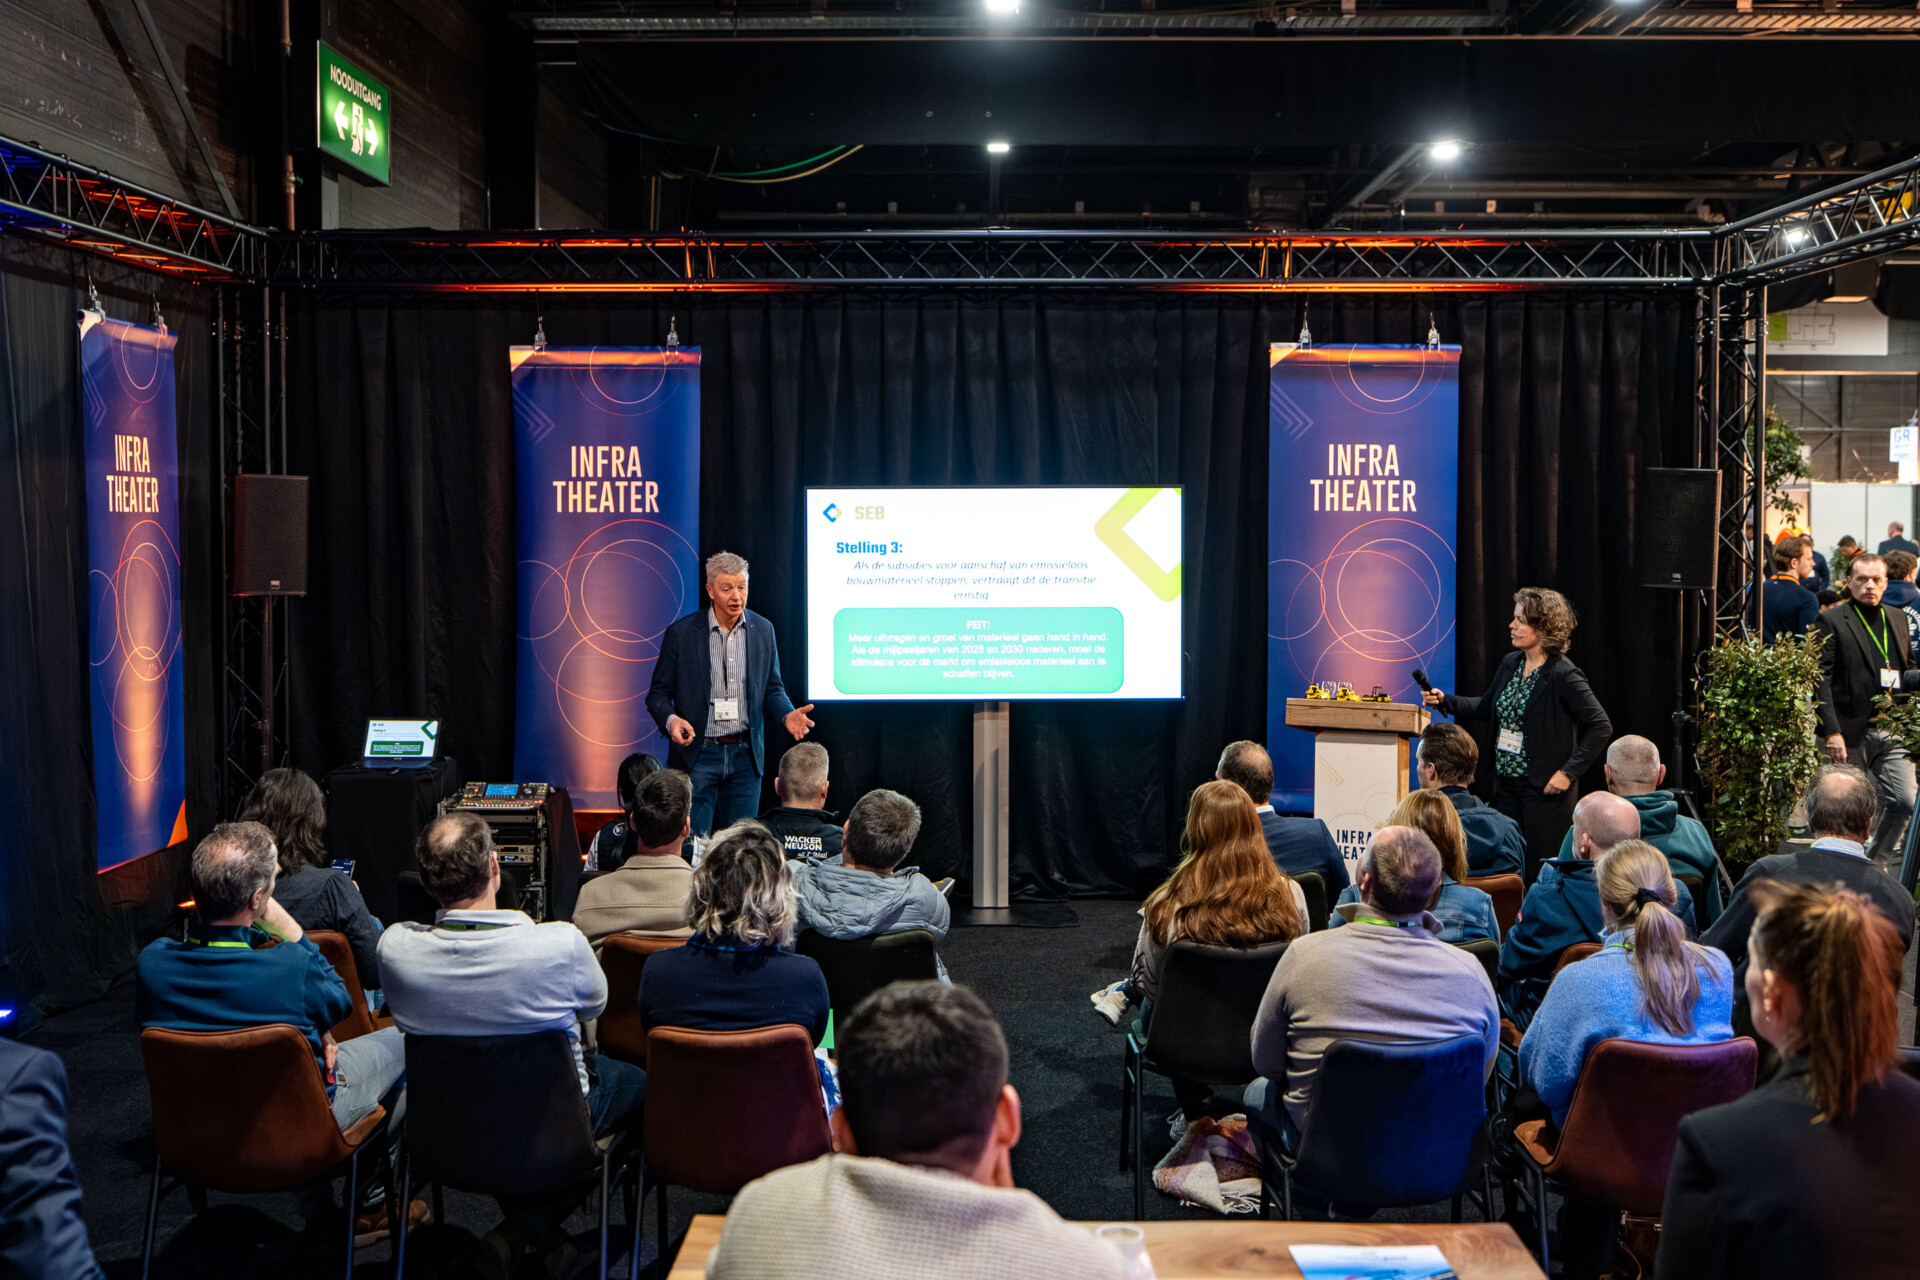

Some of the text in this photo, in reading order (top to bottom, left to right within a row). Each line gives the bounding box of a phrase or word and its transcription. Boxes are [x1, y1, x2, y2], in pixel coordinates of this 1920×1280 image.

[330, 63, 382, 111] NOODUITGANG
[115, 434, 150, 473] INFRA
[1328, 443, 1400, 476] INFRA
[571, 445, 642, 478] INFRA
[106, 475, 159, 513] THEATER
[552, 480, 660, 513] THEATER
[1309, 479, 1418, 512] THEATER
[854, 506, 885, 520] SEB
[836, 541, 903, 556] Stelling 3:
[854, 560, 869, 570] Als
[871, 560, 885, 570] de
[887, 560, 933, 570] subsidies
[936, 562, 957, 570] voor
[960, 560, 1007, 571] aanschaf
[1030, 560, 1089, 570] emissieloos
[846, 575, 1096, 586] bouwmaterieel stoppen, vertraagt dit de transitie
[953, 591, 989, 600] ernstig
[966, 620, 991, 630] FEIT:
[848, 632, 1108, 644] Meer uitvragen en groei van materieel gaan hand in hand.
[851, 645, 867, 654] Als
[868, 645, 881, 654] de
[942, 646, 960, 654] van
[961, 644, 985, 654] 2028
[986, 646, 999, 654] en
[1000, 644, 1024, 654] 2030
[1026, 645, 1067, 655] naderen,
[1068, 645, 1092, 654] moet
[1093, 645, 1106, 654] de
[850, 656, 1107, 667] stimulans voor de markt om emissieloos materieel aan te
[942, 668, 1016, 680] schaffen blijven.
[784, 835, 822, 844] WACKER
[1336, 829, 1372, 845] INFRA
[784, 842, 822, 851] NEUSON
